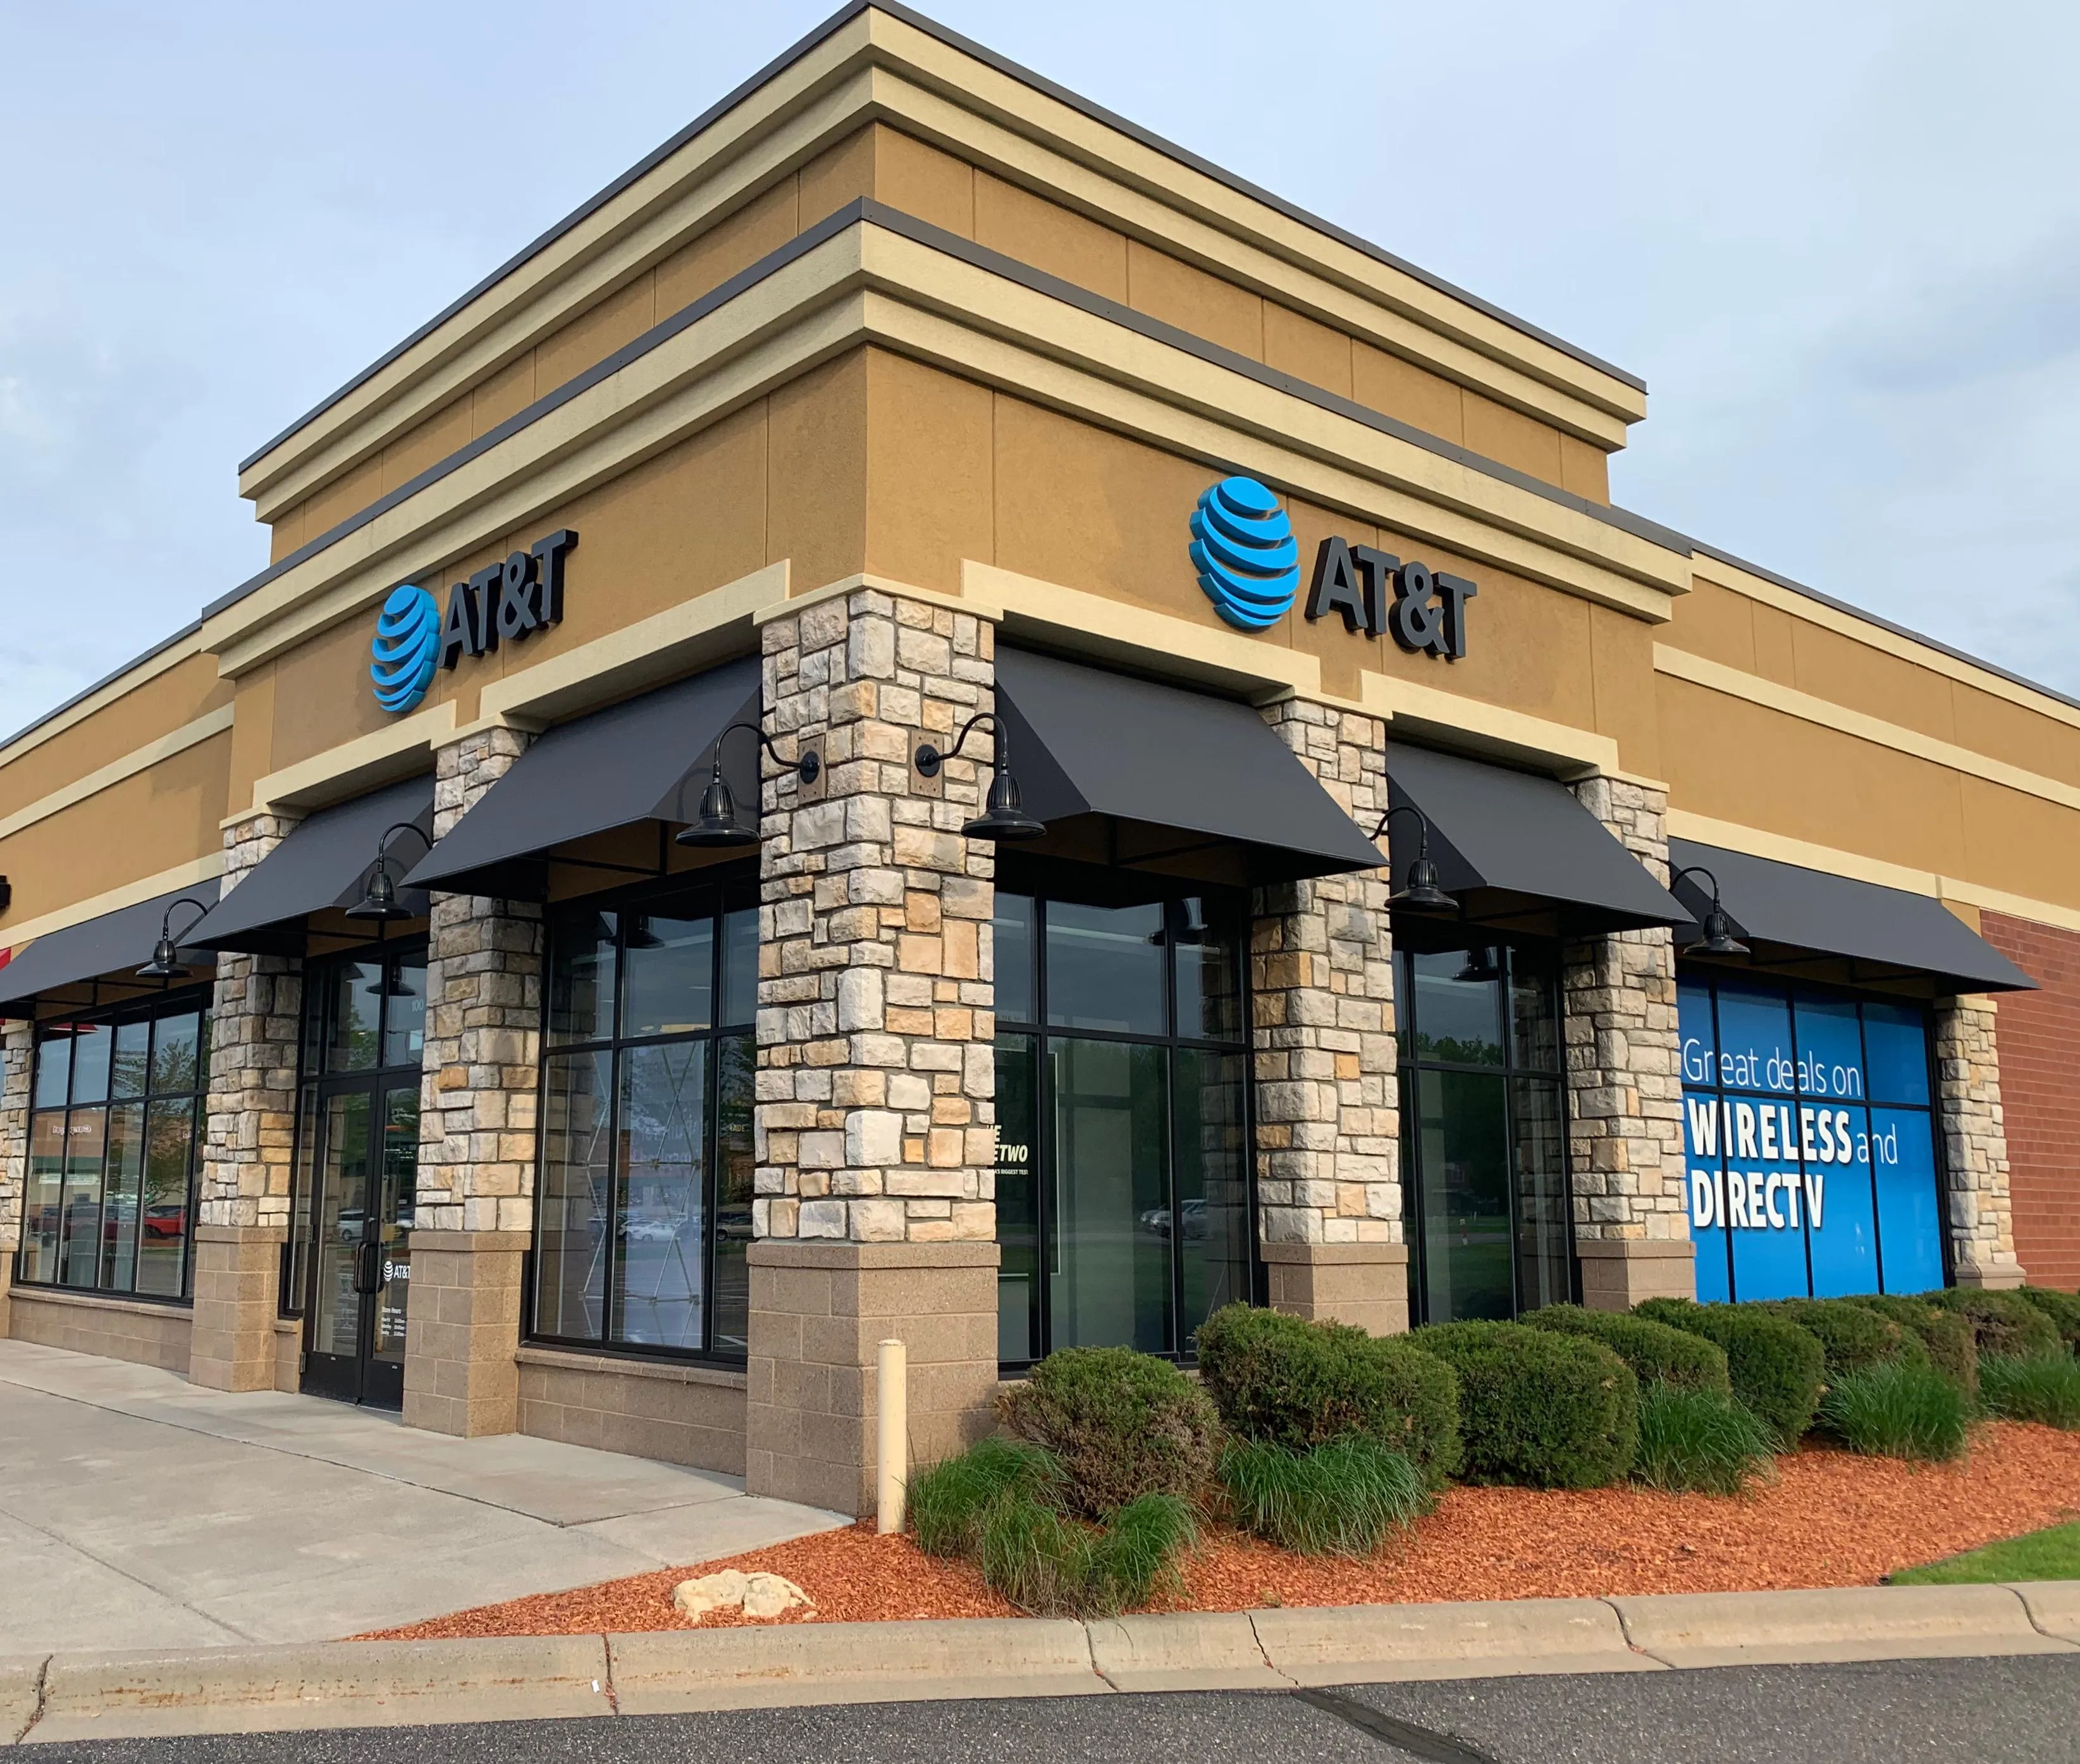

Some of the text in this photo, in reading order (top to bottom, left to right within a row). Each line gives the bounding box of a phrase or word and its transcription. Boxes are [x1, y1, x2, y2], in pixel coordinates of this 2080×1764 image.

[437, 529, 579, 670] AT&T
[1304, 536, 1477, 659] AT&T
[411, 998, 424, 1012] 100
[1683, 1038, 1861, 1097] Great deals on
[1687, 1098, 1898, 1164] WIRELESS and
[1691, 1169, 1824, 1229] DIRECTV
[393, 1265, 411, 1279] AT&T
